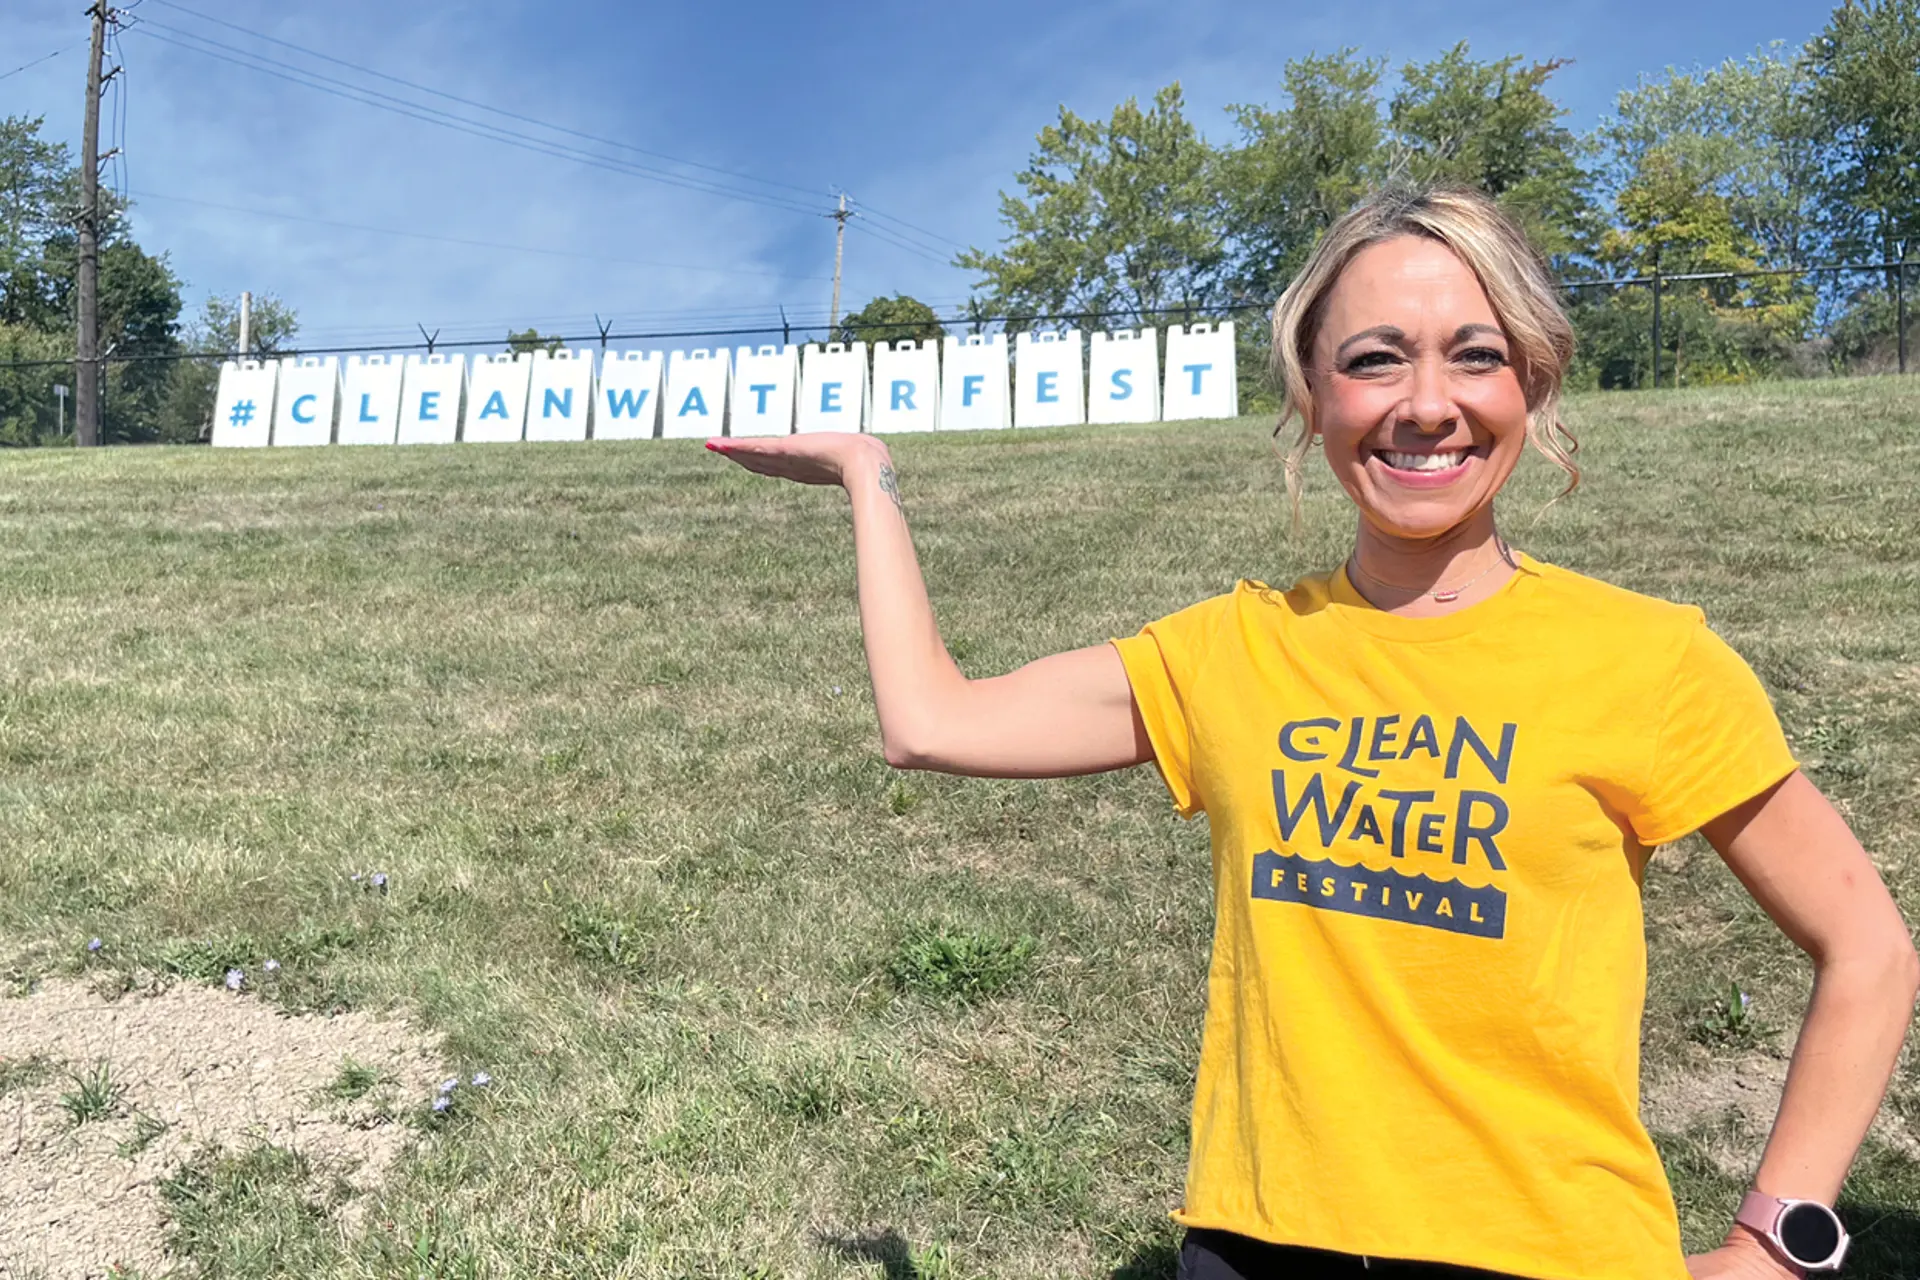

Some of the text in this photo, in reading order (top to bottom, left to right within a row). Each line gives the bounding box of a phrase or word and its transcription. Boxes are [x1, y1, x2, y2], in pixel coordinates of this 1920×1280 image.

[229, 363, 1212, 426] #CLEANWATERFEST
[1278, 714, 1517, 784] CLEAN
[1271, 769, 1510, 870] WATER
[1271, 869, 1485, 923] FESTIVAL
